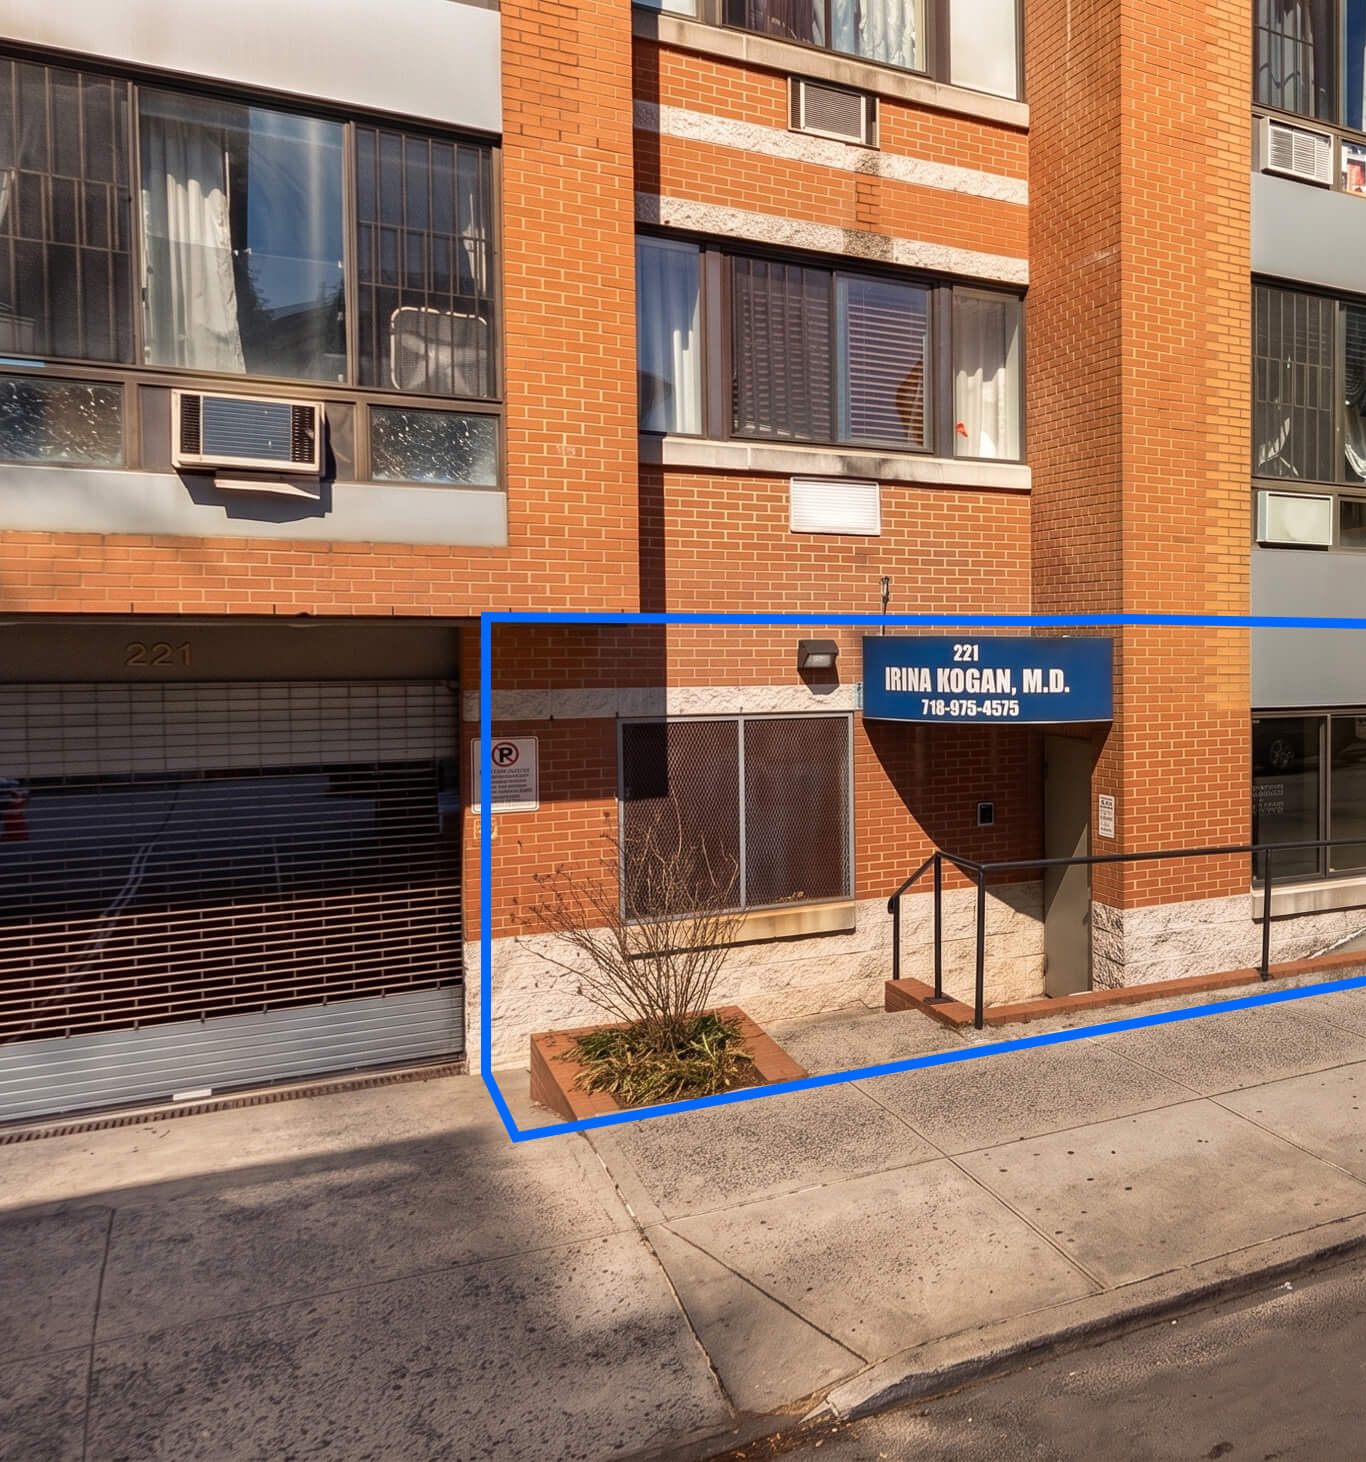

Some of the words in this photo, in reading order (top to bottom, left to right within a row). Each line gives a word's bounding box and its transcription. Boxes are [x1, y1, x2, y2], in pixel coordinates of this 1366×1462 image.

[124, 641, 192, 667] 221
[953, 644, 979, 662] 221
[885, 667, 932, 692] IRINA
[936, 667, 1017, 696] KOGAN,
[1022, 668, 1070, 693] M.D.
[921, 698, 1020, 717] 718-975-4575
